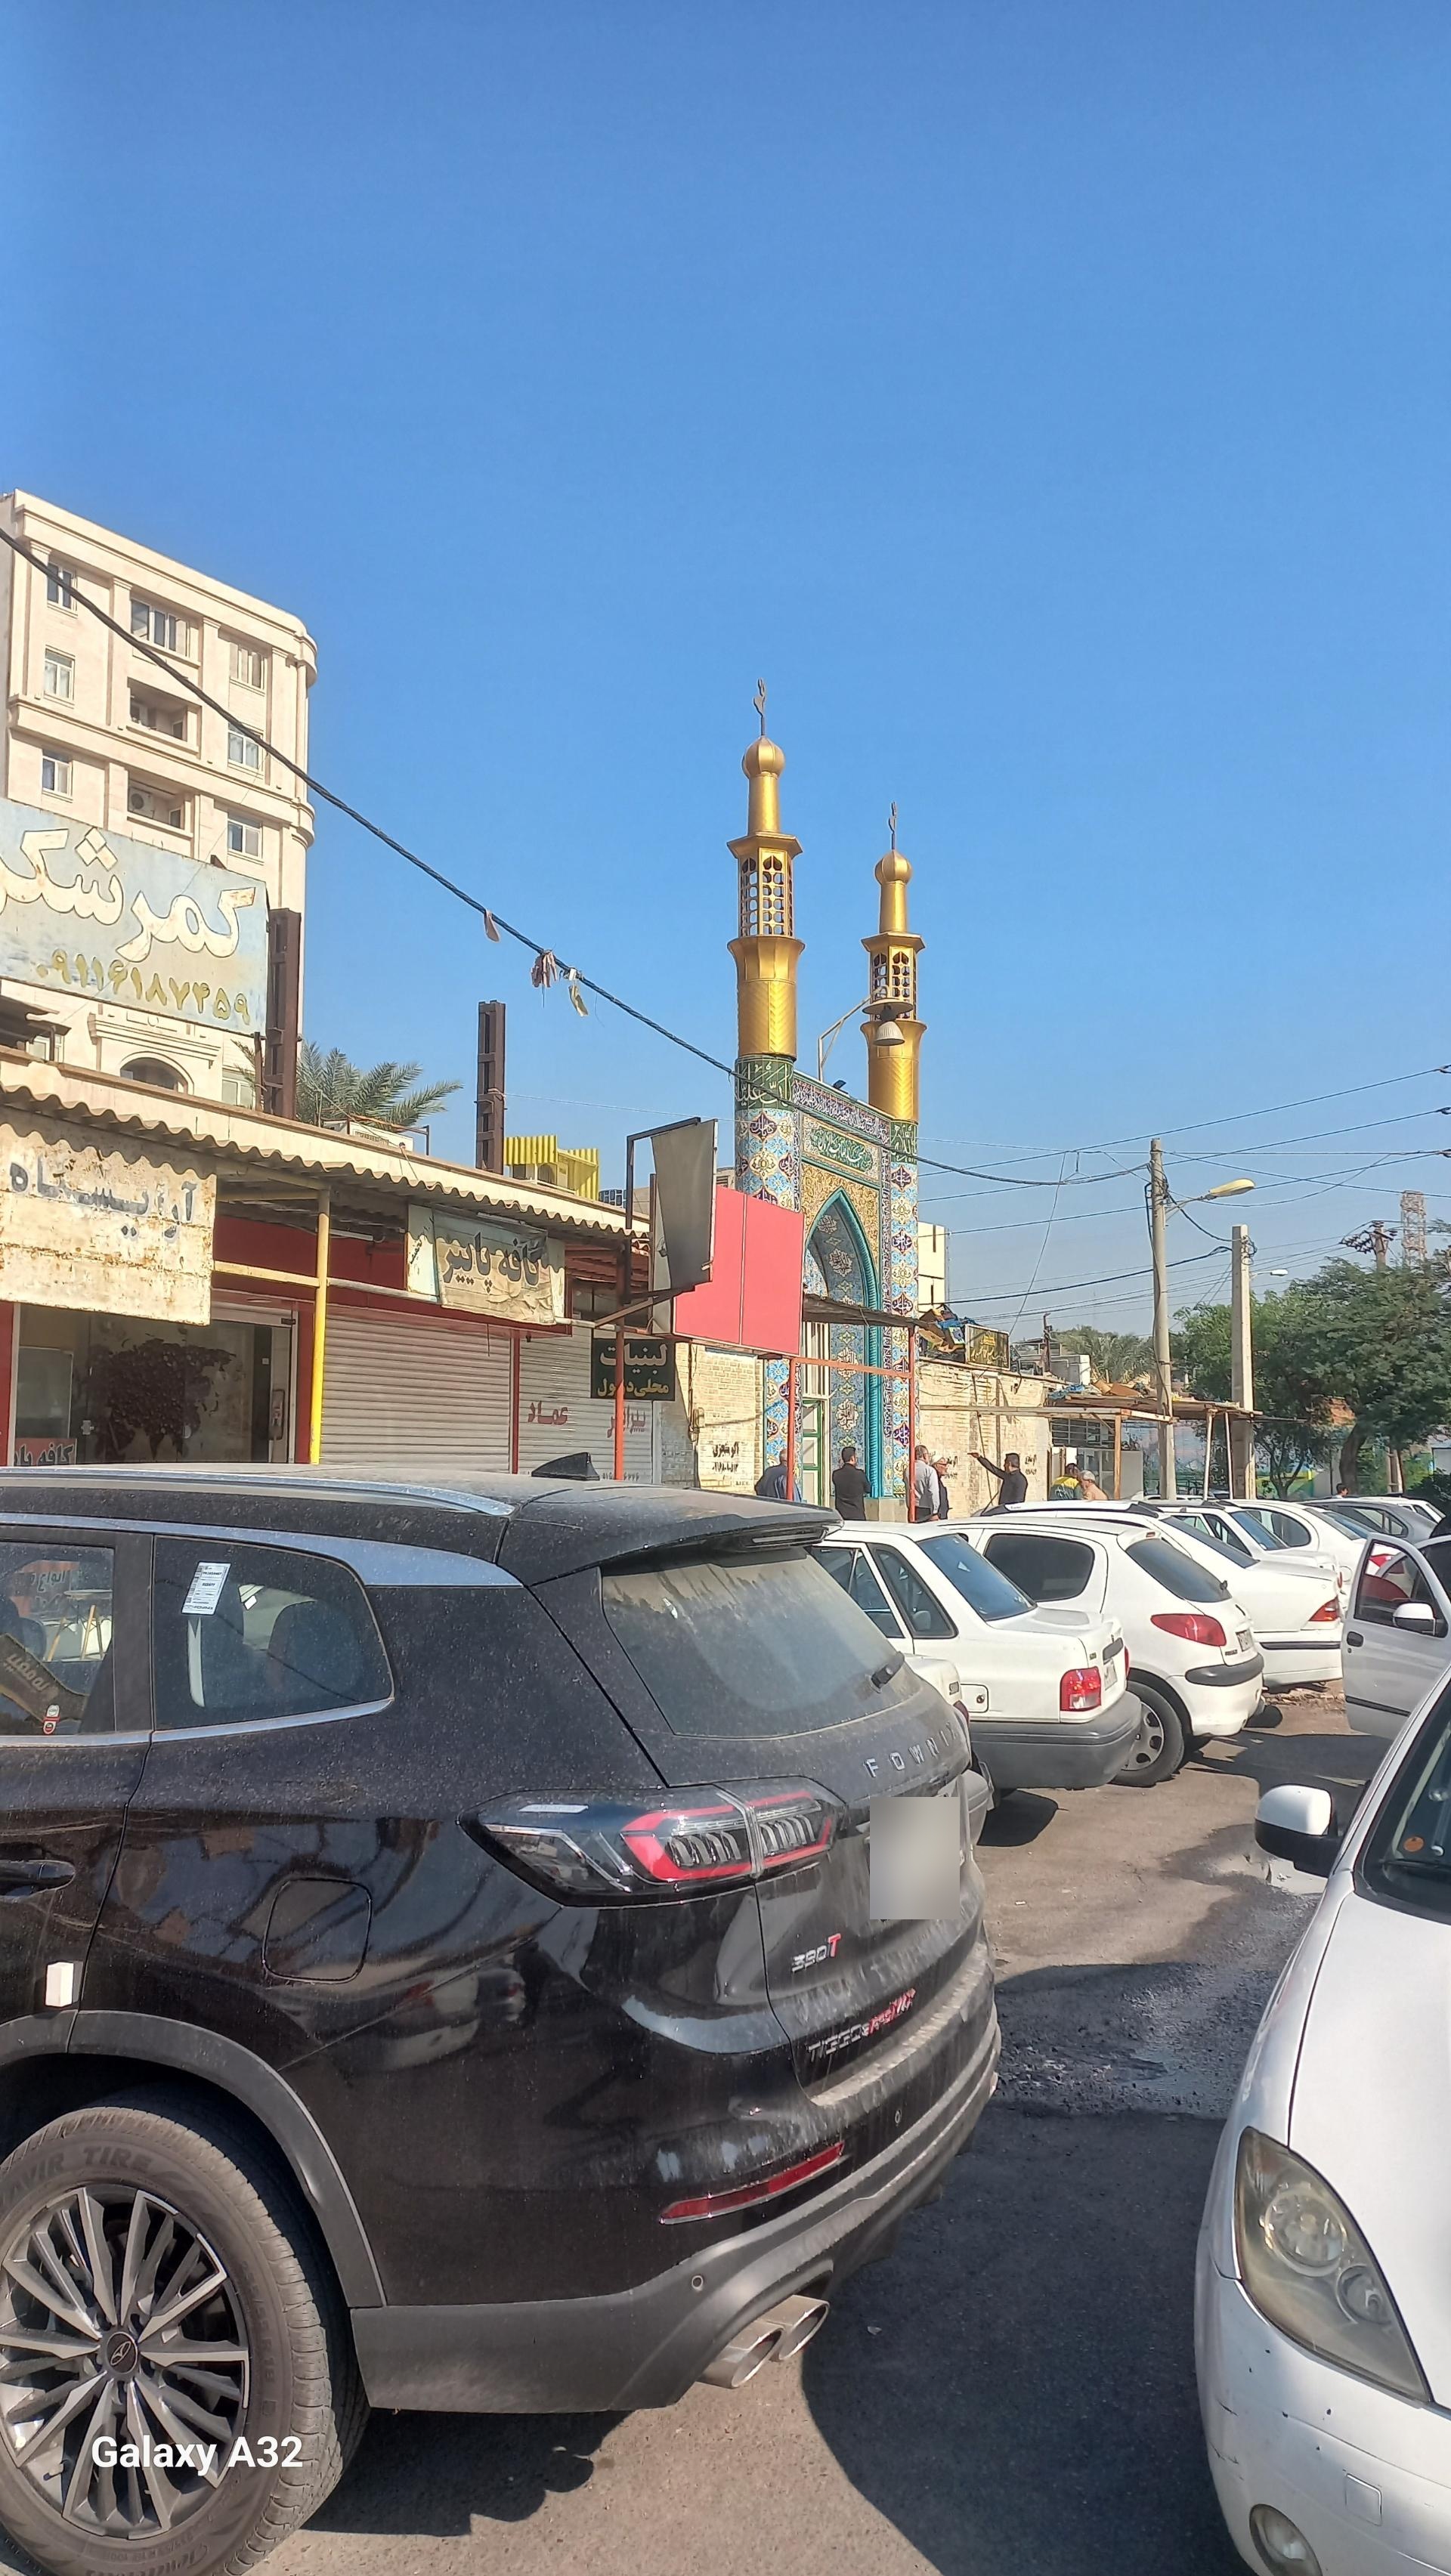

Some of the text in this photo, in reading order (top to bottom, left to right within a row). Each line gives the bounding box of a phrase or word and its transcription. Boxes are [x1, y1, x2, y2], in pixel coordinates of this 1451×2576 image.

[116, 886, 256, 963] کمر
[497, 1238, 543, 1287] کافه
[599, 1342, 668, 1375] لبنیات
[633, 1378, 669, 1397] محلی
[792, 1933, 842, 1972] 390T
[82, 2145, 153, 2174] TIRE
